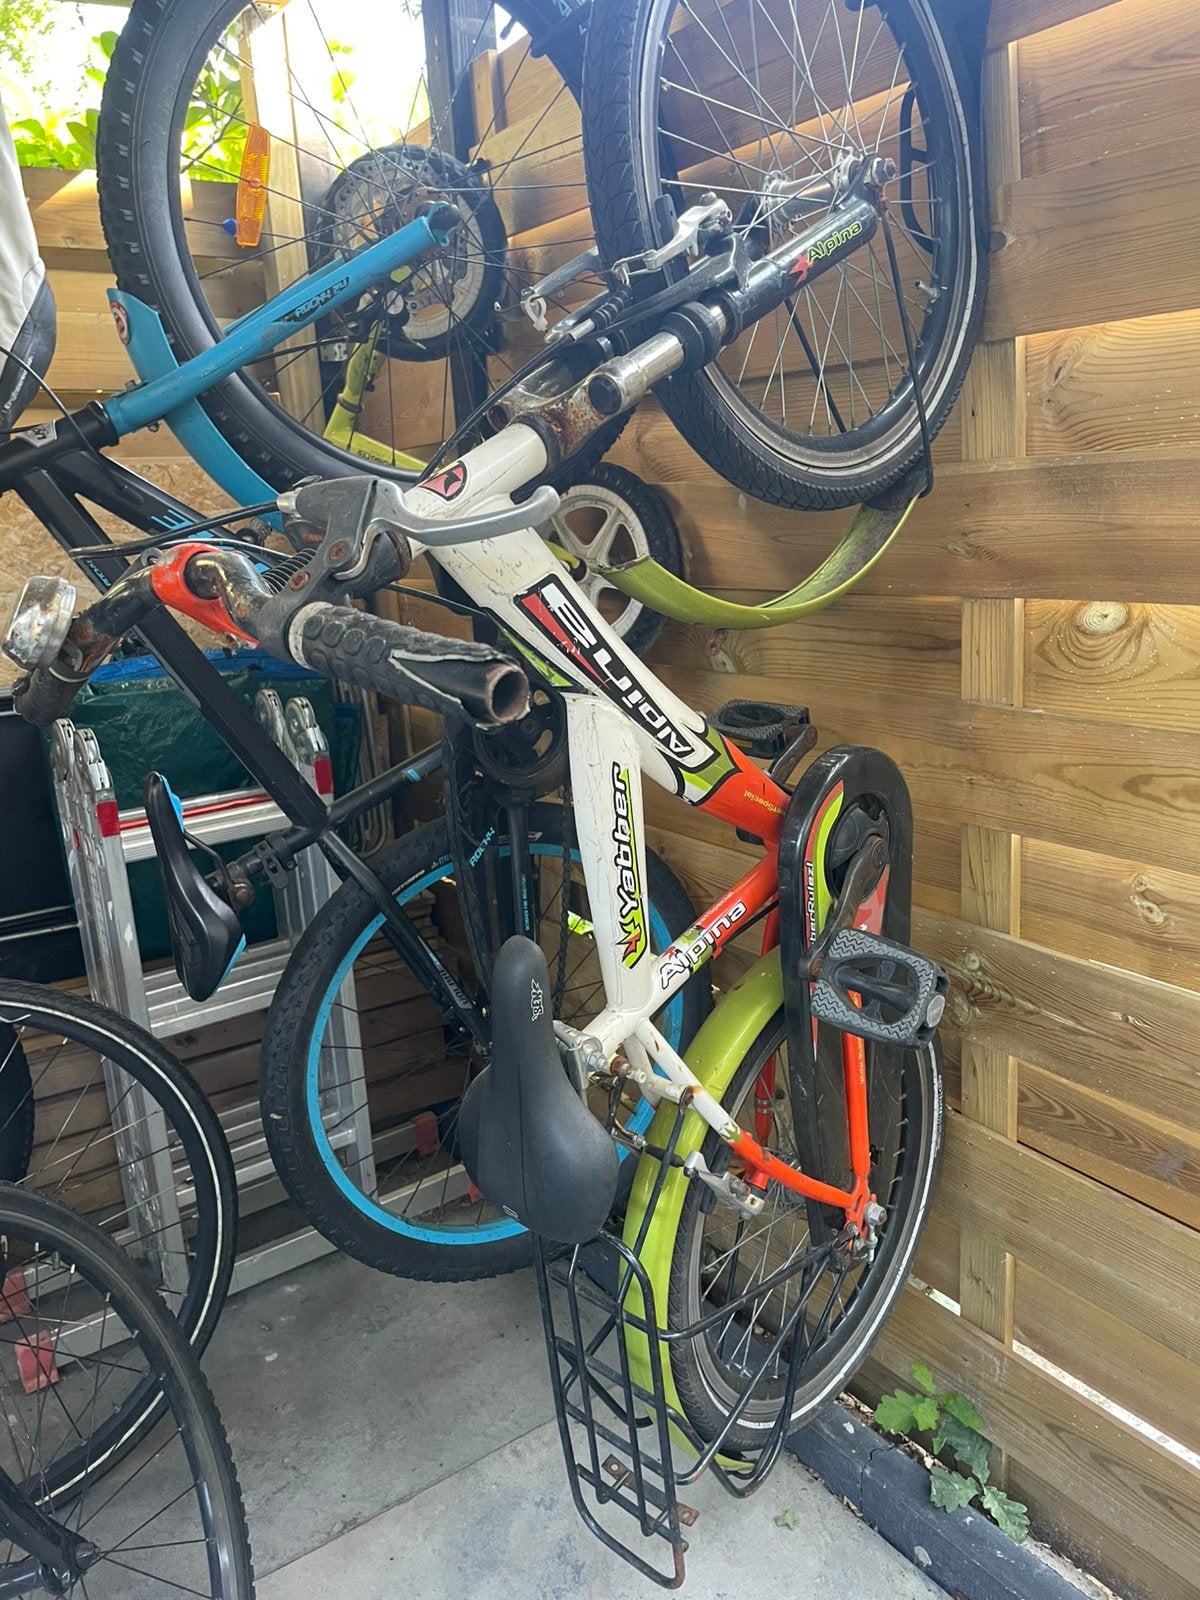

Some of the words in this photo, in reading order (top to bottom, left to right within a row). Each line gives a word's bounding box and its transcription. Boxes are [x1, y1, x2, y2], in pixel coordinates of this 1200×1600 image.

[807, 221, 862, 265] Alpina
[540, 583, 692, 754] Alpina
[612, 761, 639, 919] Yabber
[660, 901, 747, 989] Alpina
